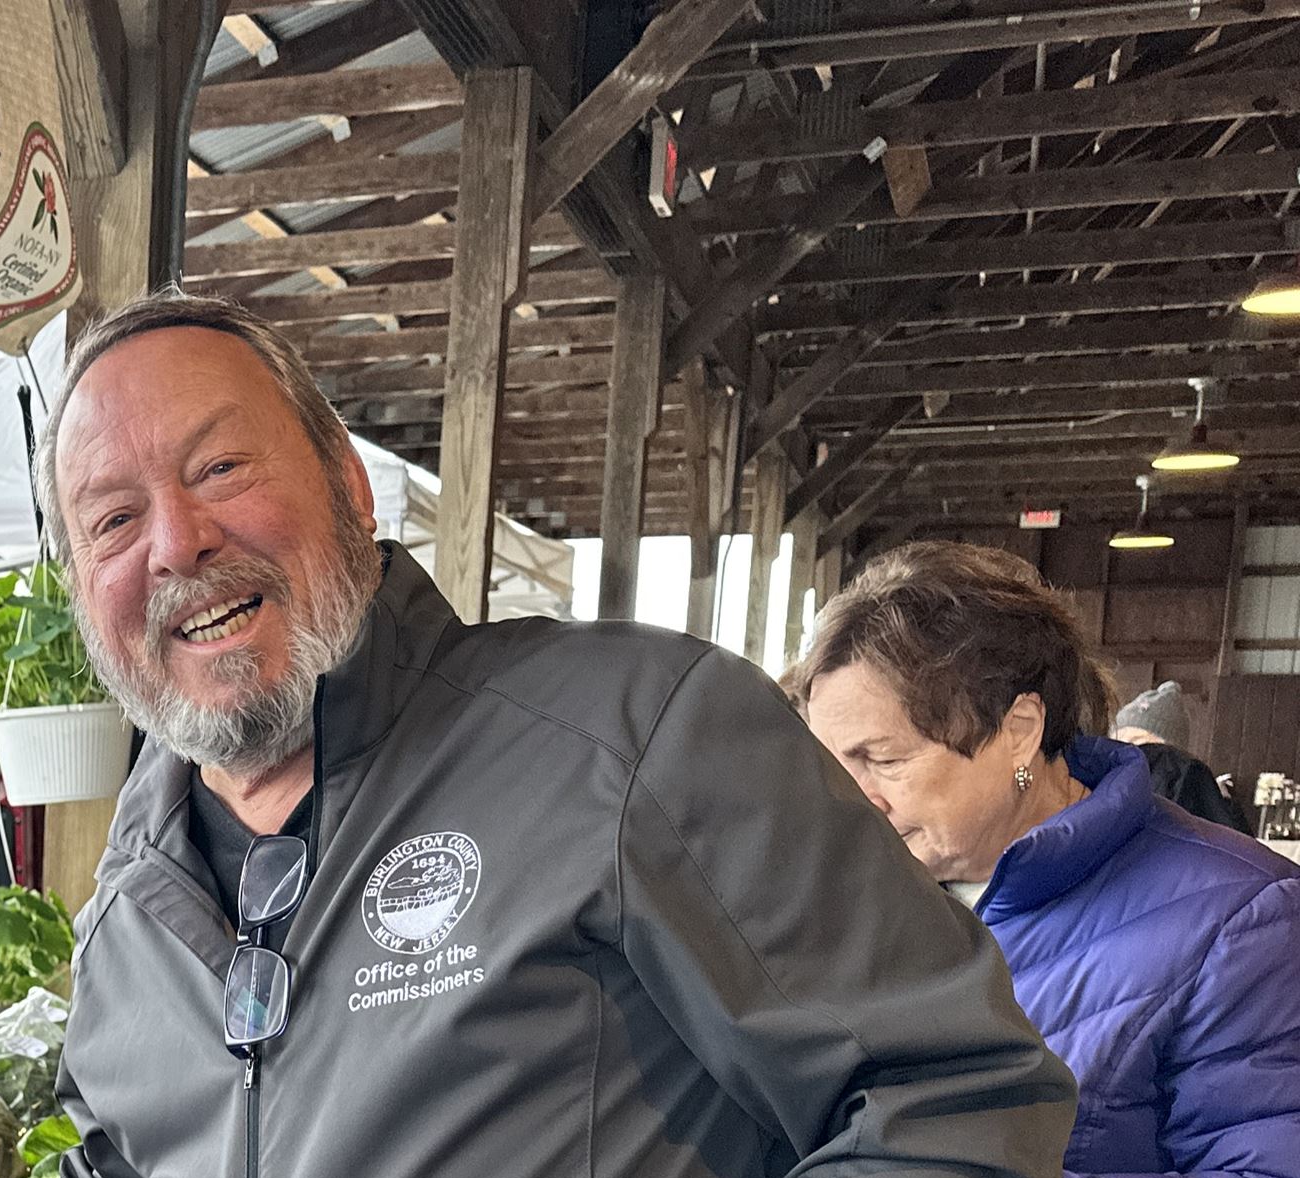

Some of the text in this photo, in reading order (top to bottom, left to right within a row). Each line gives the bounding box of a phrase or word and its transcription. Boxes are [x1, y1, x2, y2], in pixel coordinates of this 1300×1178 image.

[366, 835, 479, 898] BURLINGTON COUNTY
[411, 852, 447, 870] 1694
[373, 908, 460, 953] NEW JERSEY
[354, 943, 478, 987] Office of the
[347, 966, 485, 1013] Commissioners
